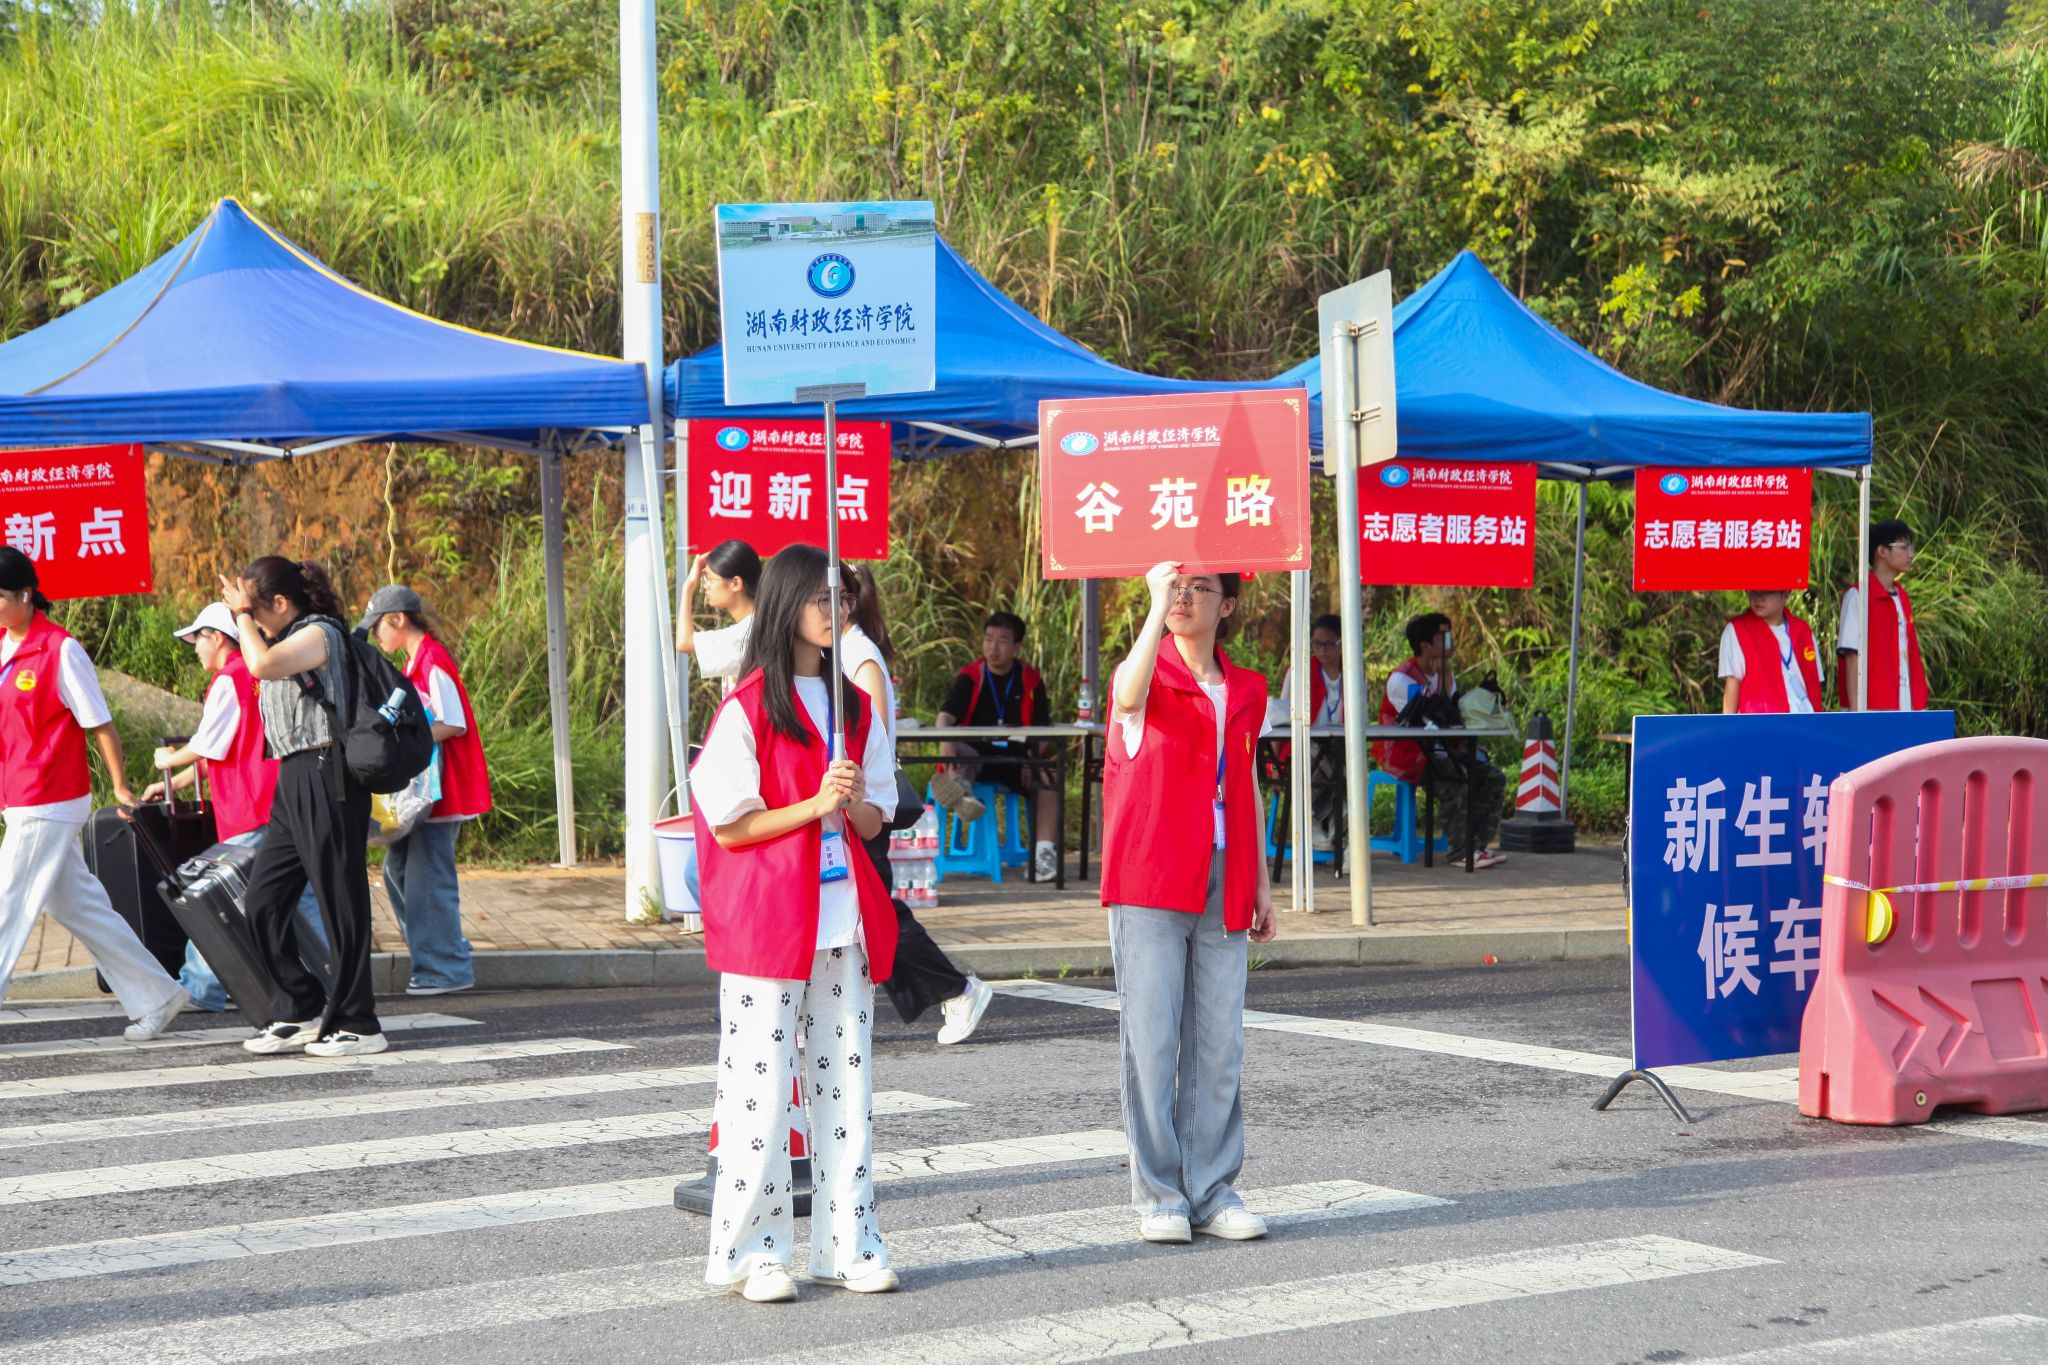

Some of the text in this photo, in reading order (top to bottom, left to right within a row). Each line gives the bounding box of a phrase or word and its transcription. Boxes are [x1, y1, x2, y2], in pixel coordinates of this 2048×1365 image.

[746, 302, 915, 339] 湖南财政经济学院
[746, 337, 916, 353] HUNAN UNIVERSITY OF FINANCE AND ECONOMICS
[752, 429, 864, 449] 湖南财政经学院
[1103, 426, 1221, 446] 湖南财政经济学院
[1412, 467, 1513, 484] 湖南财政经济学院
[1691, 475, 1789, 489] 湖南财政经济学院
[709, 470, 869, 522] 迎新点
[1075, 474, 1275, 534] 谷苑路
[1363, 512, 1527, 546] 志愿者服务站
[1644, 519, 1802, 549] 志愿者服务站
